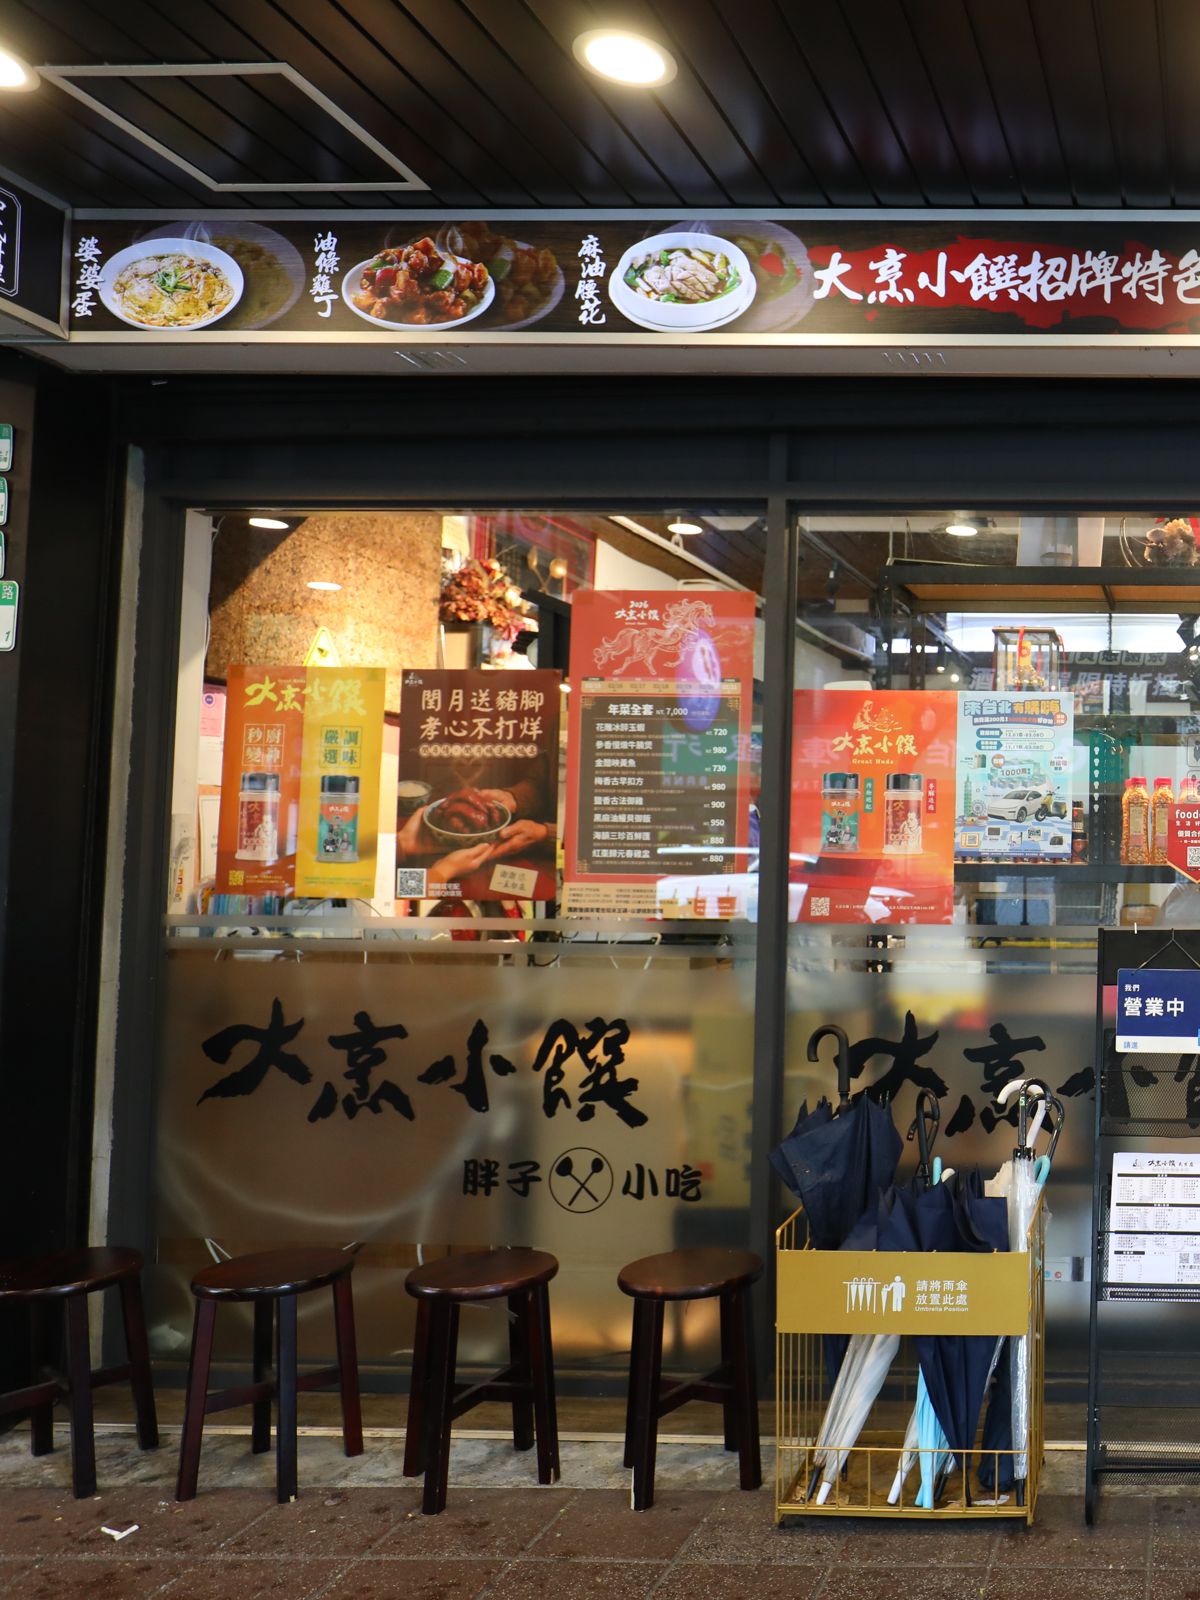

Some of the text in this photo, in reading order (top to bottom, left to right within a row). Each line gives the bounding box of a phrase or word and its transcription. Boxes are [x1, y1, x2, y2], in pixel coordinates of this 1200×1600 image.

[71, 236, 106, 317] 婆婆蛋
[309, 231, 341, 319] 油條雞丁
[575, 234, 607, 326] 麻油腰花
[421, 688, 544, 713] 閏月送豬腳
[608, 703, 654, 716] 年菜全套
[666, 708, 689, 717] 7,000
[419, 716, 544, 741] 孝心不打烊
[713, 728, 728, 736] 720
[712, 746, 727, 754] 980
[832, 731, 918, 756] 大烹小饌
[712, 764, 727, 772] 730
[711, 783, 726, 791] 980
[711, 801, 726, 809] 900
[710, 819, 725, 827] 950
[709, 837, 724, 845] 880
[709, 855, 724, 863] 880
[1124, 984, 1140, 992] 我們
[1123, 996, 1185, 1018] 營業中
[196, 997, 649, 1129] 大烹小饌
[462, 1158, 704, 1202] 胖子 小吃
[915, 1280, 968, 1292] 請將雨傘
[915, 1293, 968, 1306] 放置此處
